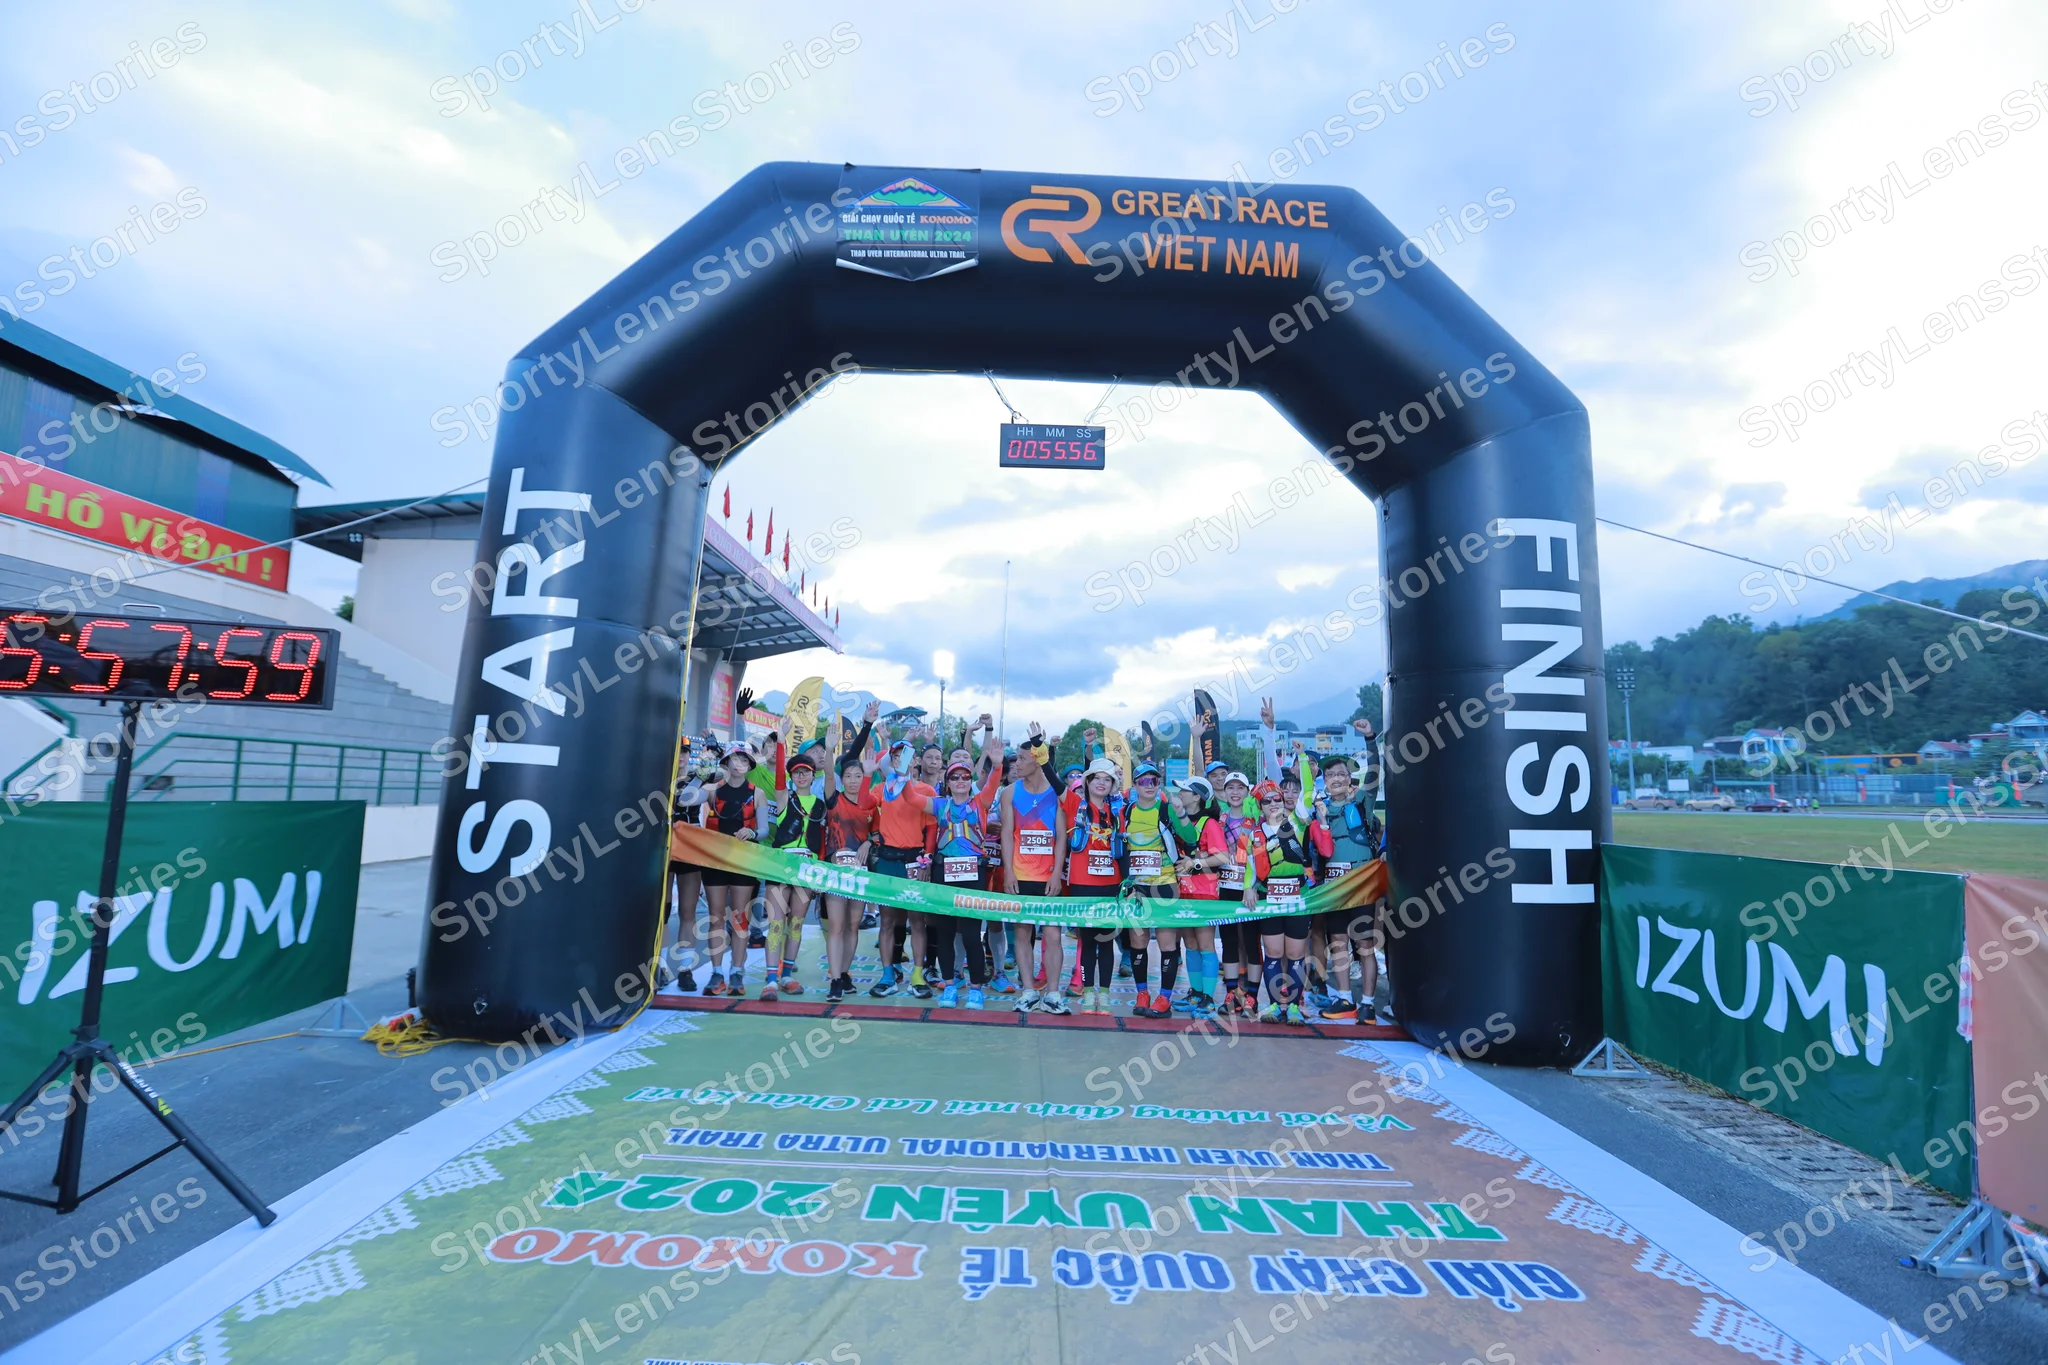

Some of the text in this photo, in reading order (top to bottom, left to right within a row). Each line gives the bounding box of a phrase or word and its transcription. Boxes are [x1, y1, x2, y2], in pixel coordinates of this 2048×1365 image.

[1112, 189, 1329, 228] GREAT RACE
[919, 215, 973, 224] KOMOMO
[844, 228, 972, 242] THAN UYÊN 2024
[850, 249, 866, 257] THAN
[883, 250, 928, 258] INTERNATIONAL
[929, 250, 948, 258] ULTRA
[948, 250, 966, 258] TRAIL
[1142, 232, 1299, 279] VIET NAM
[1016, 426, 1092, 438] HH MM SS
[25, 483, 104, 528] HỒ
[120, 511, 172, 549] VĨ
[179, 532, 249, 574] ĐẠI
[260, 557, 273, 581] !
[457, 467, 593, 877] START
[1498, 517, 1595, 904] FINISH
[1026, 836, 1047, 845] 2506
[951, 863, 971, 872] 2575
[1135, 858, 1155, 866] 2556
[1221, 871, 1239, 880] 2503
[1328, 869, 1345, 877] 2579
[1273, 885, 1294, 894] 2567
[953, 894, 1022, 913] KOMOMO
[1025, 901, 1064, 917] THAN
[18, 869, 321, 1004] IZUMI
[1636, 915, 1888, 1066] IZUMI
[743, 1091, 861, 1111] Châu
[863, 1095, 939, 1115] Lai
[945, 1099, 1018, 1118] núi
[1131, 1104, 1272, 1124] những
[664, 1128, 1395, 1171] THAN UYEN INTERNATIONAL ULTRA TRAIL
[542, 1169, 1508, 1242] THAN UYÊN 2024
[484, 1227, 1586, 1312] GIẢI CHẠY QUỐC TẾ KOMOMO
